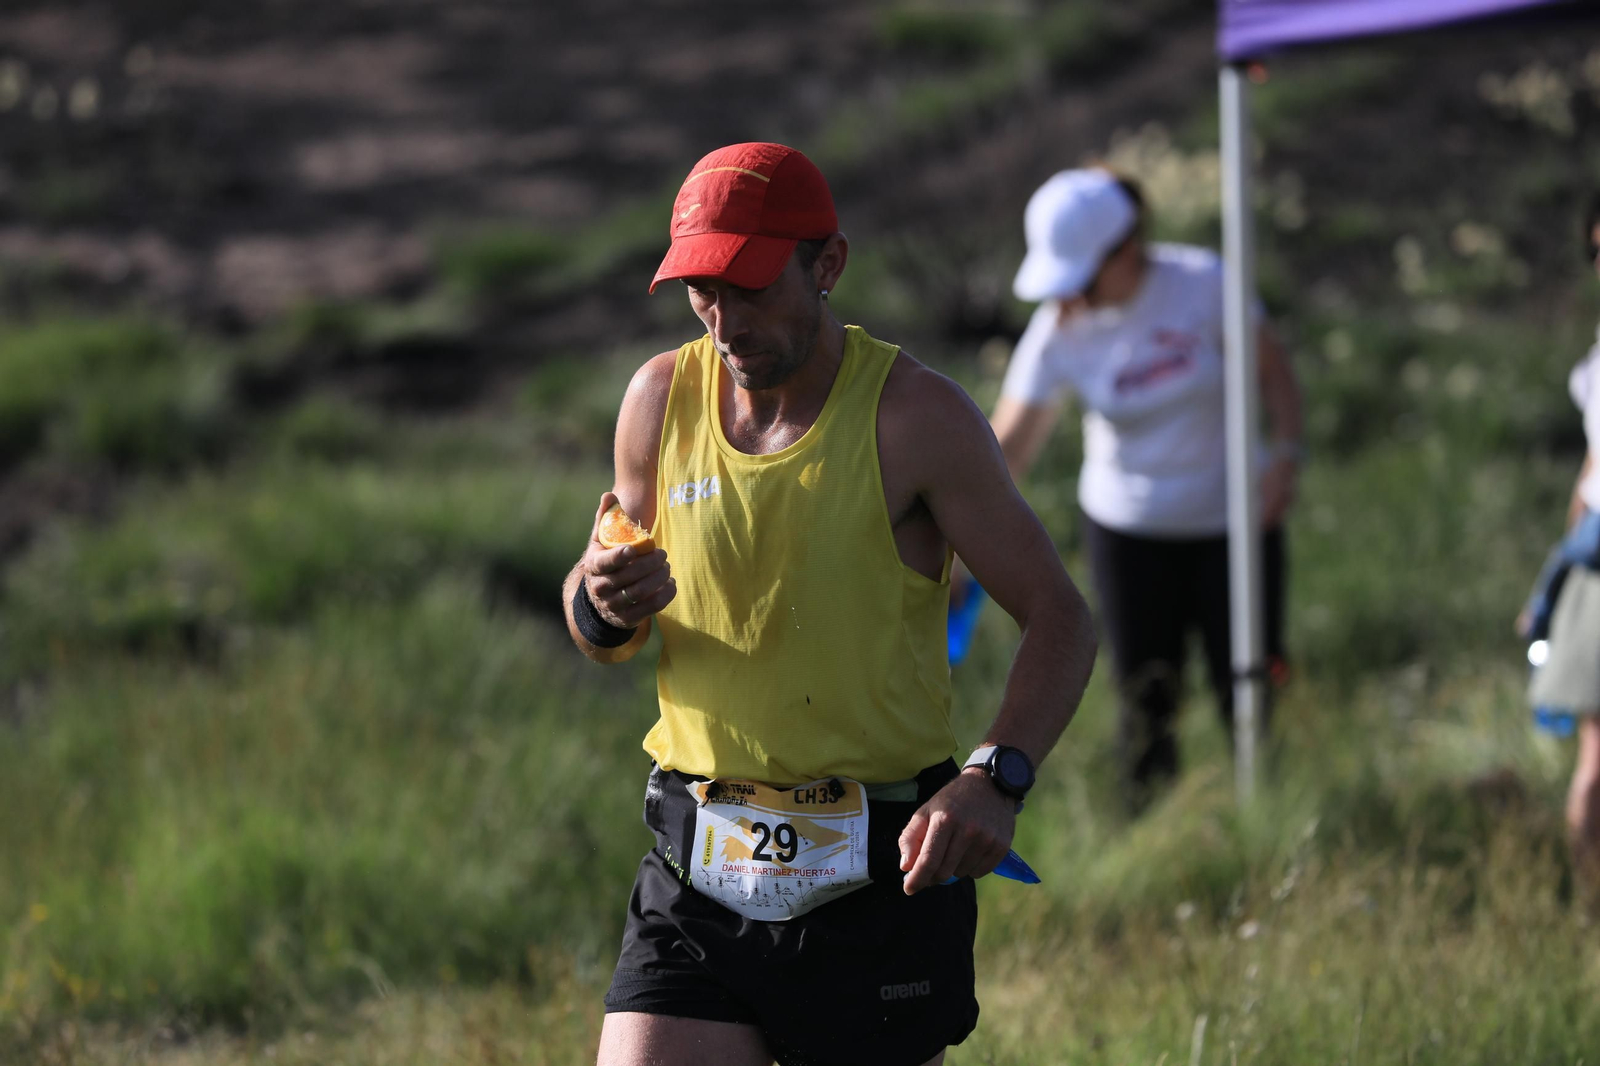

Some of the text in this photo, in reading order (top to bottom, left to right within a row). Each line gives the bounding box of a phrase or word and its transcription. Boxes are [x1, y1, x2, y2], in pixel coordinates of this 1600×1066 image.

[669, 475, 720, 508] HOKA
[730, 783, 757, 796] TRAIL
[751, 821, 798, 863] 29
[722, 864, 836, 877] DANIEL MARTINEZ PUERTAS
[880, 980, 931, 1000] arena
